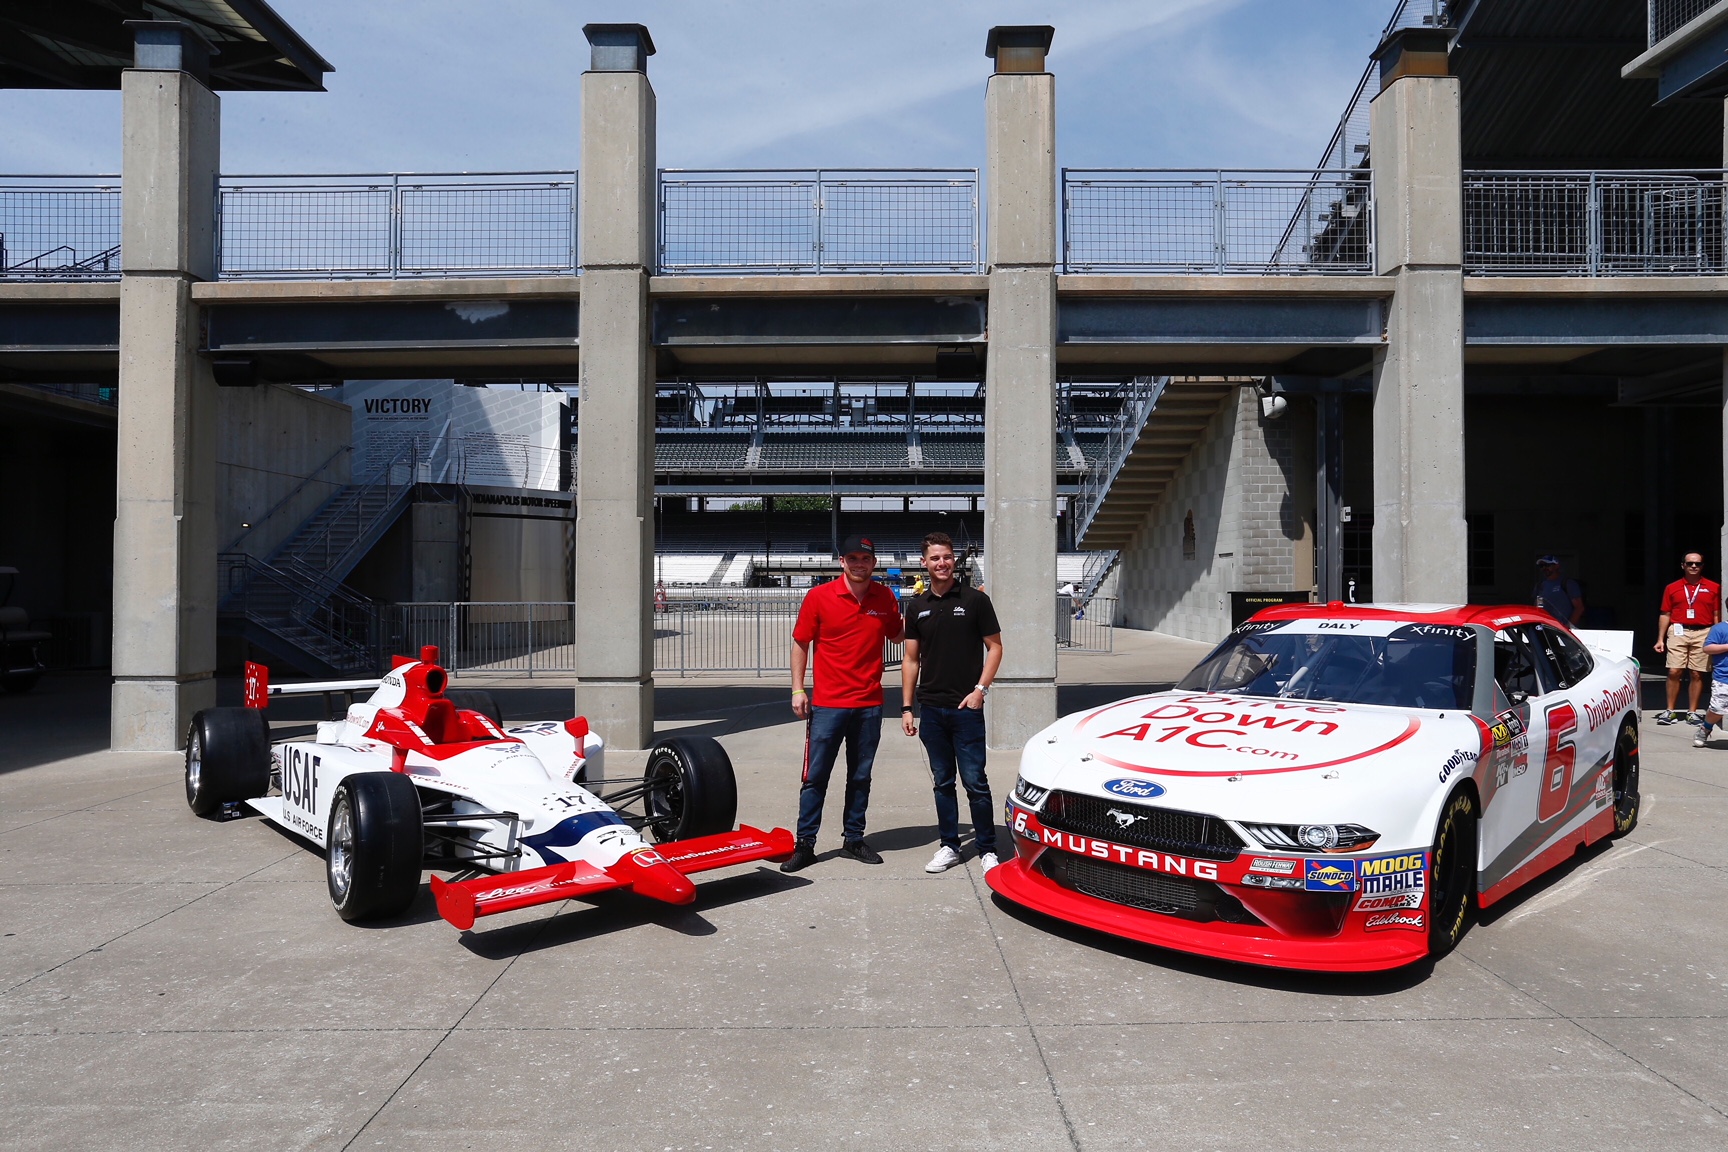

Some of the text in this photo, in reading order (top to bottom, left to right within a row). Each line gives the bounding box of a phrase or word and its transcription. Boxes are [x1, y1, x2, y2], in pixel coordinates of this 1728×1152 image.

[364, 398, 432, 414] VICTORY
[521, 496, 543, 508] MOTOR
[1234, 621, 1281, 634] xfinity
[1318, 622, 1360, 630] DALY
[1410, 625, 1476, 641] xfinity
[1177, 695, 1347, 714] Drive
[1140, 704, 1339, 736] Down
[1097, 722, 1300, 761] A1C.com
[1536, 699, 1578, 824] 6
[284, 744, 322, 816] USAF
[1112, 779, 1155, 796] Ford
[555, 795, 587, 808] 17
[302, 819, 323, 841] FORCE
[1014, 812, 1028, 832] 6
[1043, 828, 1218, 880] MUSTANG
[1360, 853, 1424, 877] MOOG
[1307, 870, 1354, 881] SUNOCO
[1363, 870, 1424, 894] MAHLE
[1358, 894, 1406, 909] COMP
[1366, 912, 1423, 927] Edelbrock
